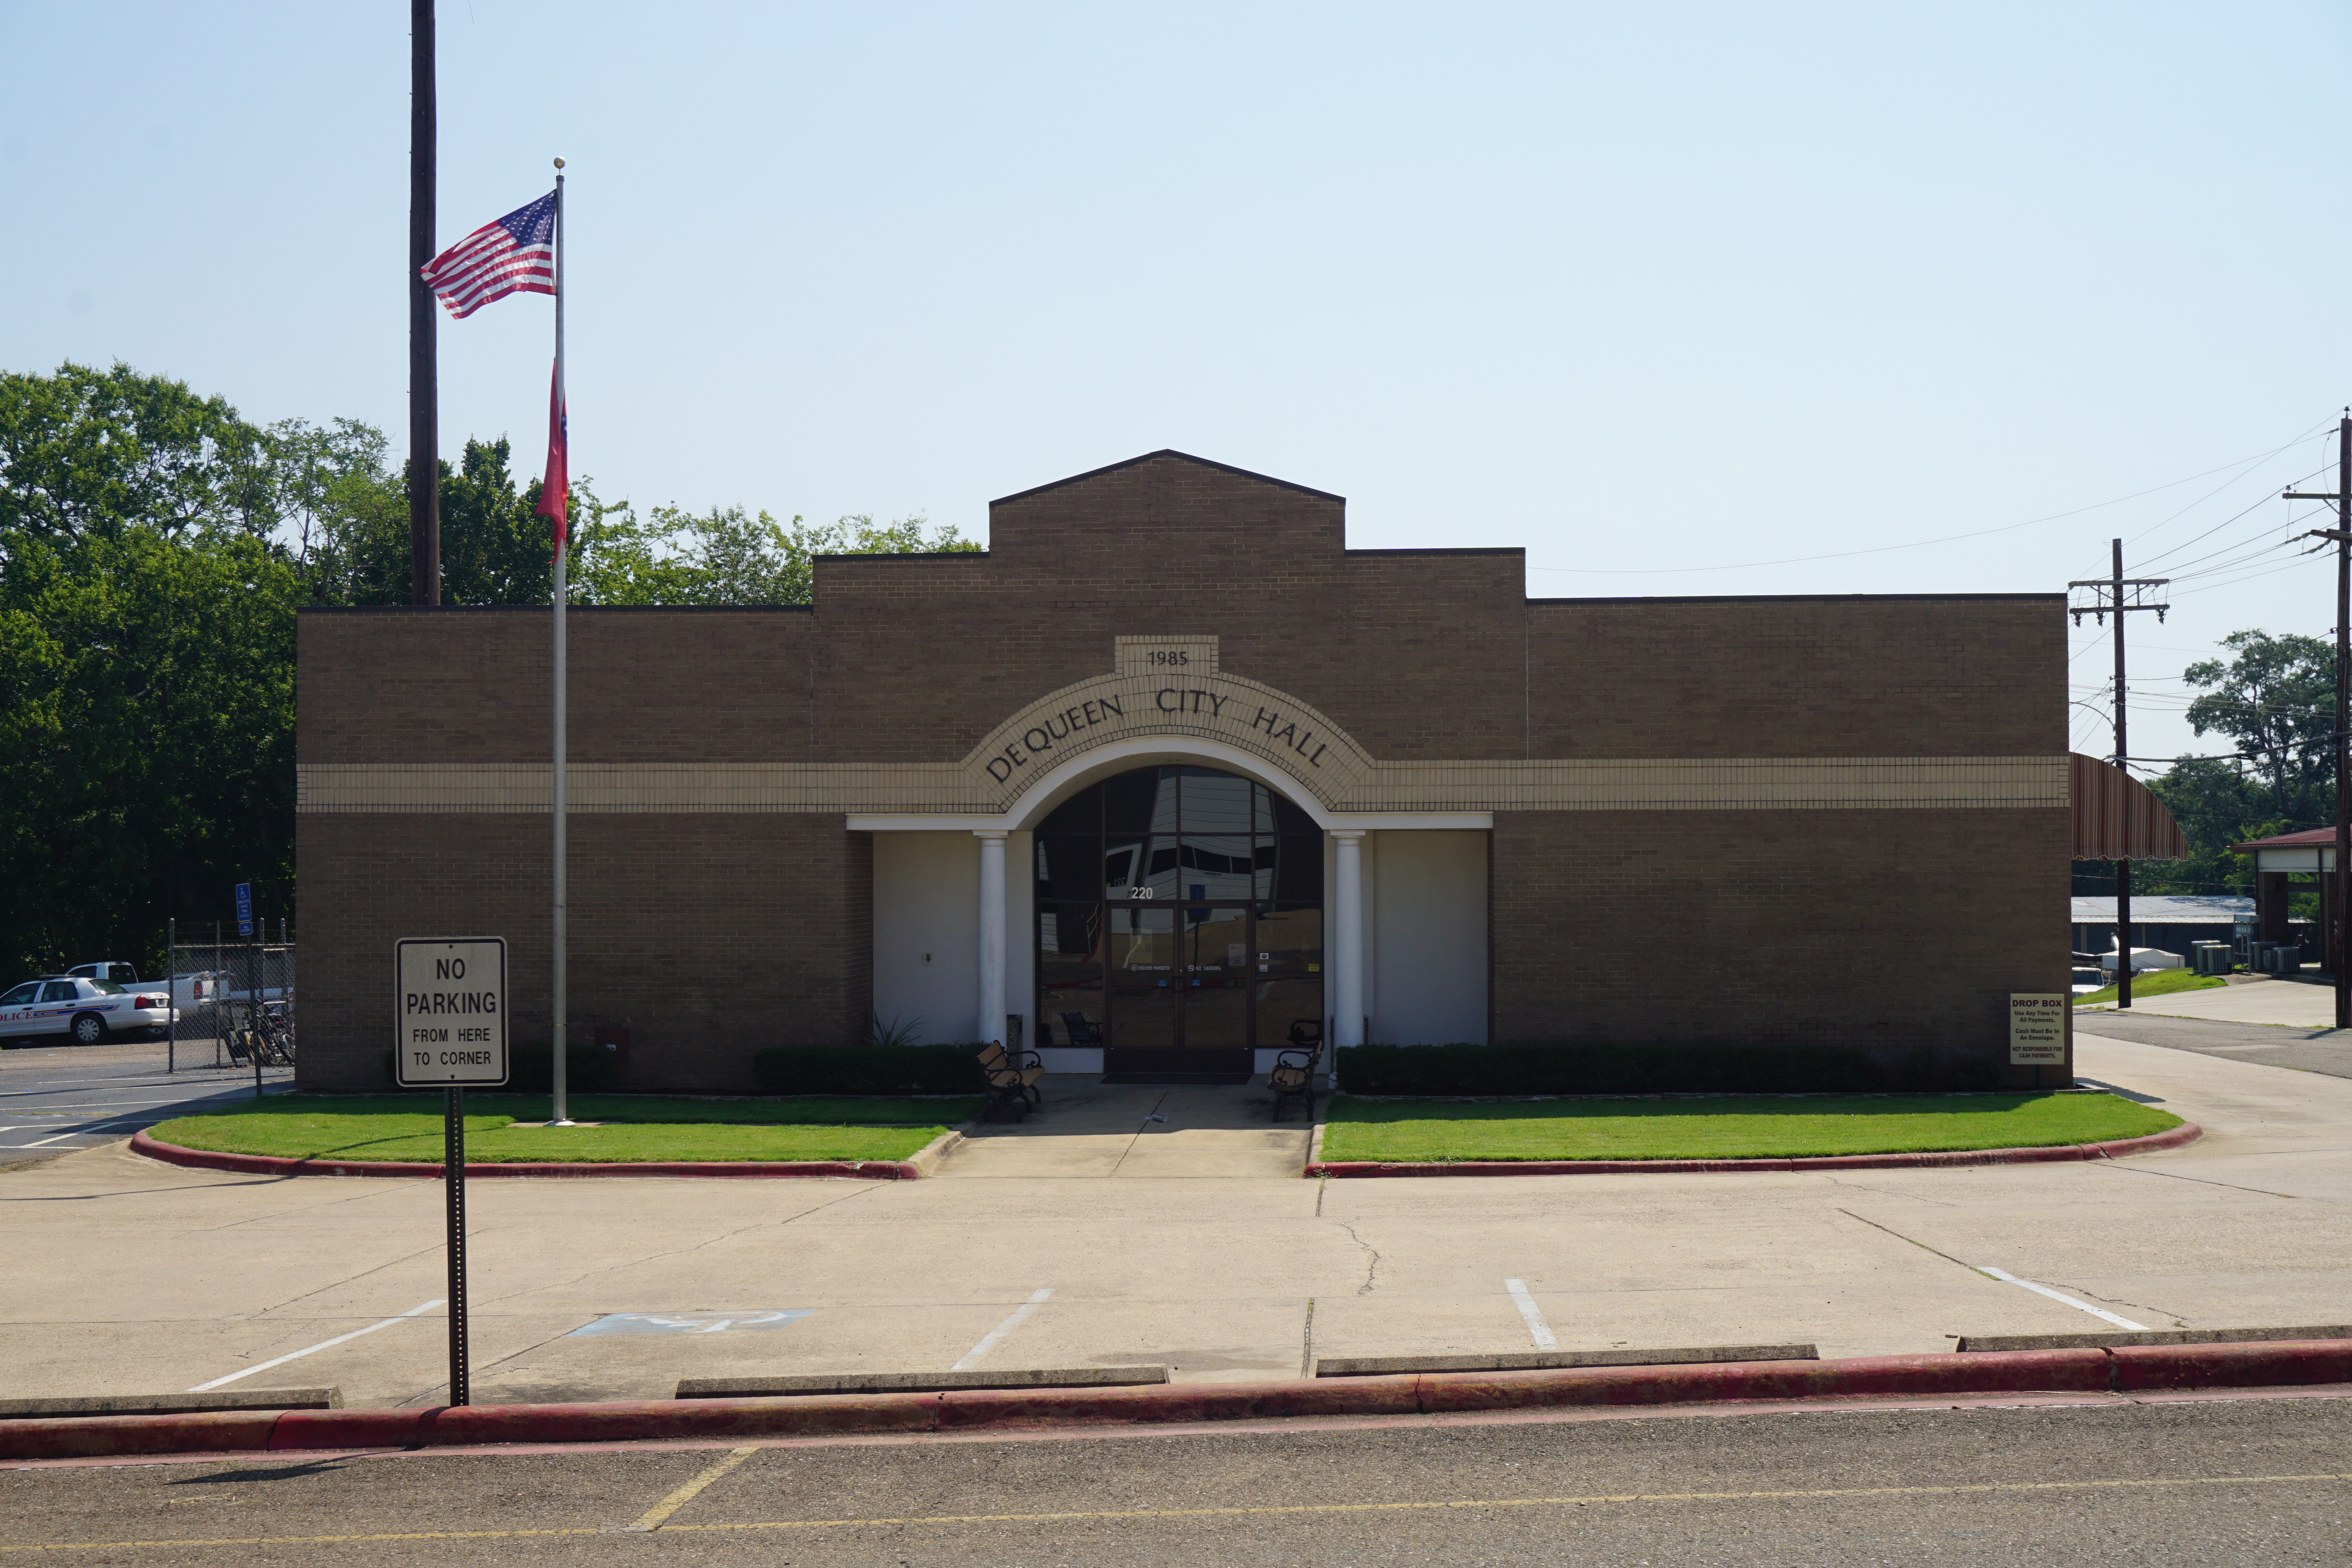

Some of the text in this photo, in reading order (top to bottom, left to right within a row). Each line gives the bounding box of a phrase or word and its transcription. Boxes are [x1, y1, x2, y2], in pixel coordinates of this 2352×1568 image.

[1148, 651, 1188, 666] 1985
[986, 688, 1327, 783] DE QUEEN CITY HALL
[1131, 887, 1153, 899] 220
[437, 958, 465, 980] NO
[407, 992, 496, 1014] PARKING
[413, 1028, 490, 1042] FROM HERE
[414, 1051, 491, 1065] TO CORNER
